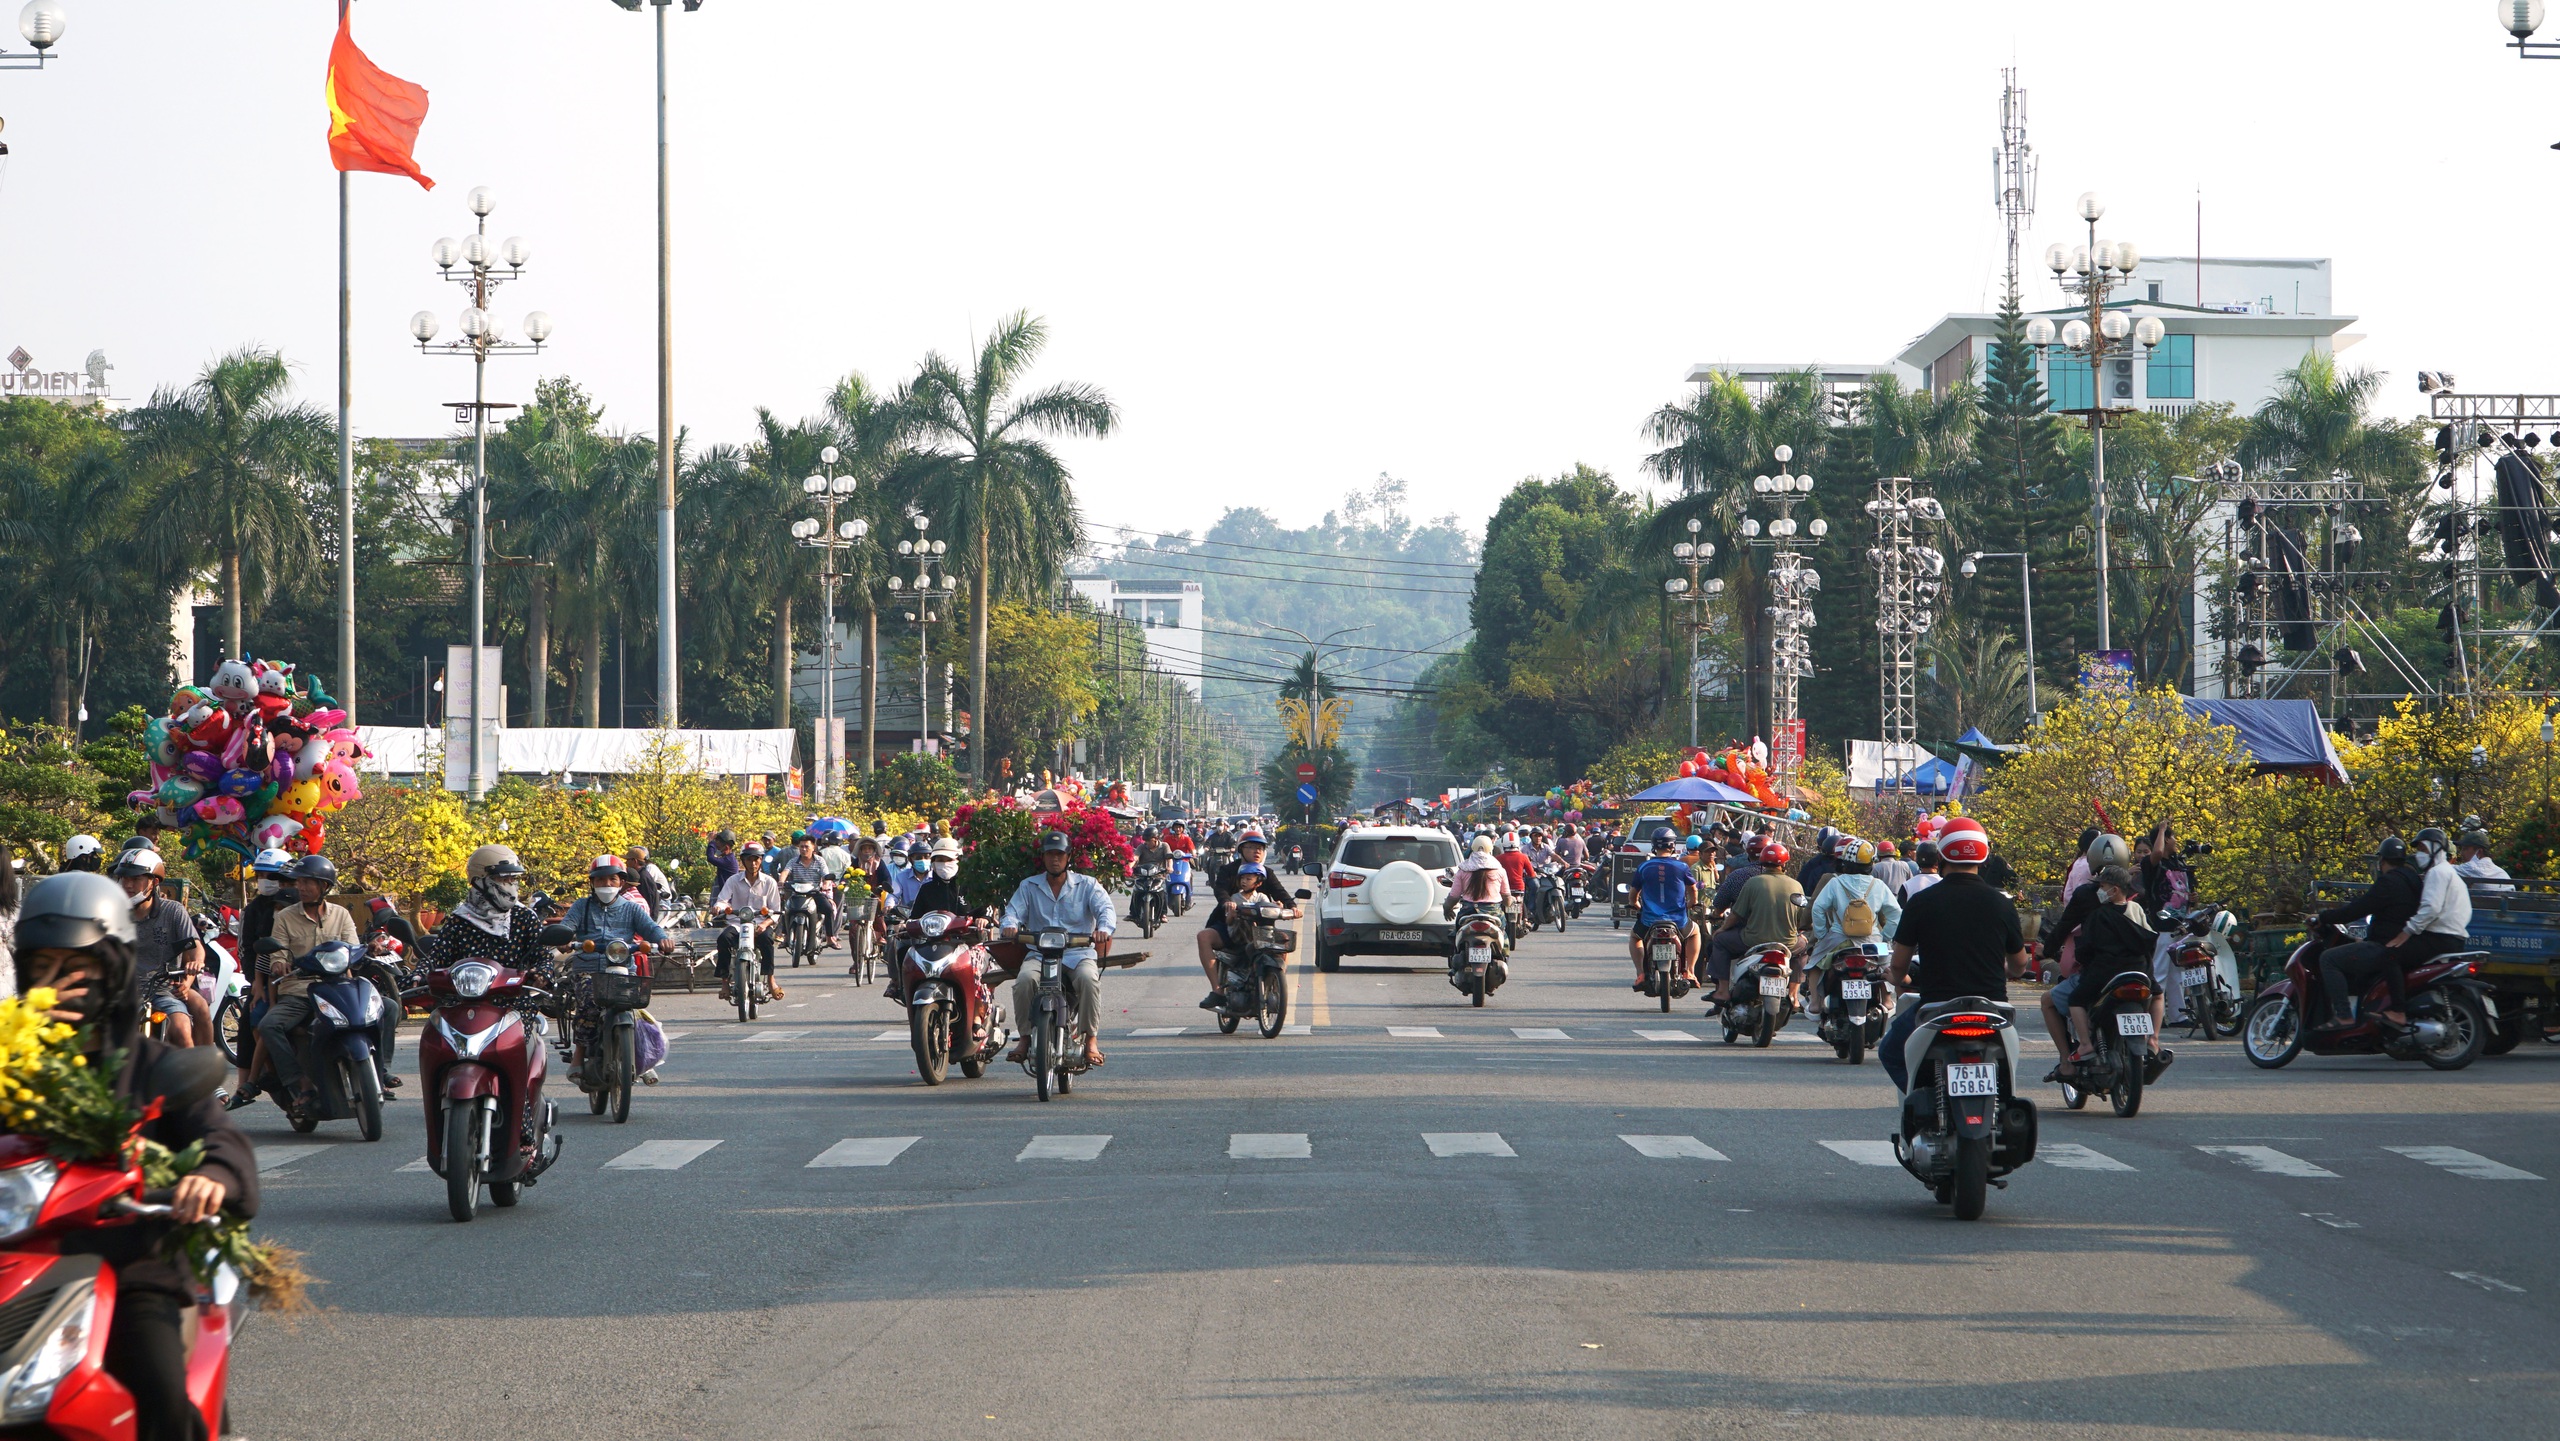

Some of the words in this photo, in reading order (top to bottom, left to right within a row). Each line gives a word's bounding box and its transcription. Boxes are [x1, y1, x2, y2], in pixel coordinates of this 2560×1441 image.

[1184, 584, 1200, 592] AIA
[1381, 931, 1421, 940] 76A-028.65
[2123, 1024, 2149, 1034] 5903
[1954, 1065, 1989, 1080] 76-AA
[1951, 1080, 1994, 1094] 058.64
